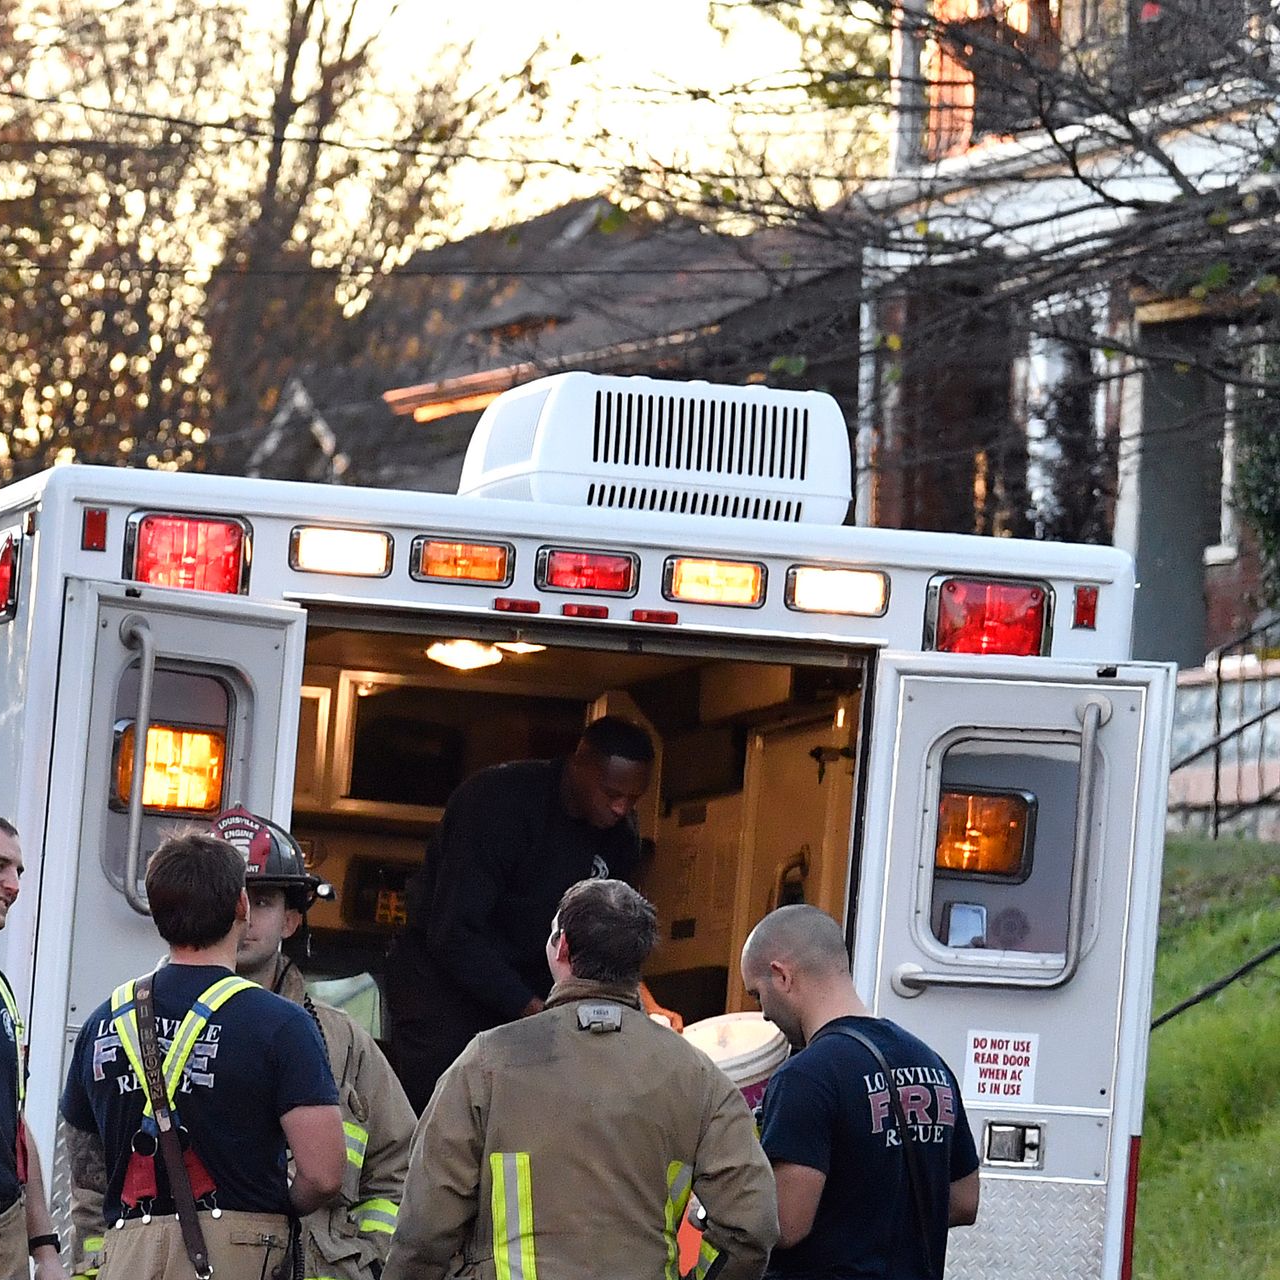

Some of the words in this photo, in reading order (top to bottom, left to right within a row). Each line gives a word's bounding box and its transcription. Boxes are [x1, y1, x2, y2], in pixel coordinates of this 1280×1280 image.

[218, 816, 260, 830] LOUISVILLE
[224, 829, 255, 840] ENGINE
[973, 1037, 987, 1050] DO
[990, 1038, 1011, 1051] NOT
[1013, 1040, 1031, 1053] USE
[93, 1035, 219, 1088] FE
[973, 1052, 999, 1066] REAR
[1003, 1054, 1031, 1067] DOOR
[863, 1066, 950, 1094] LOSVILLE
[979, 1067, 1008, 1081] WHEN
[1010, 1069, 1023, 1081] AC
[977, 1082, 986, 1094] IS
[989, 1083, 1000, 1095] IN
[1003, 1083, 1021, 1096] USE
[868, 1085, 955, 1134] FRE
